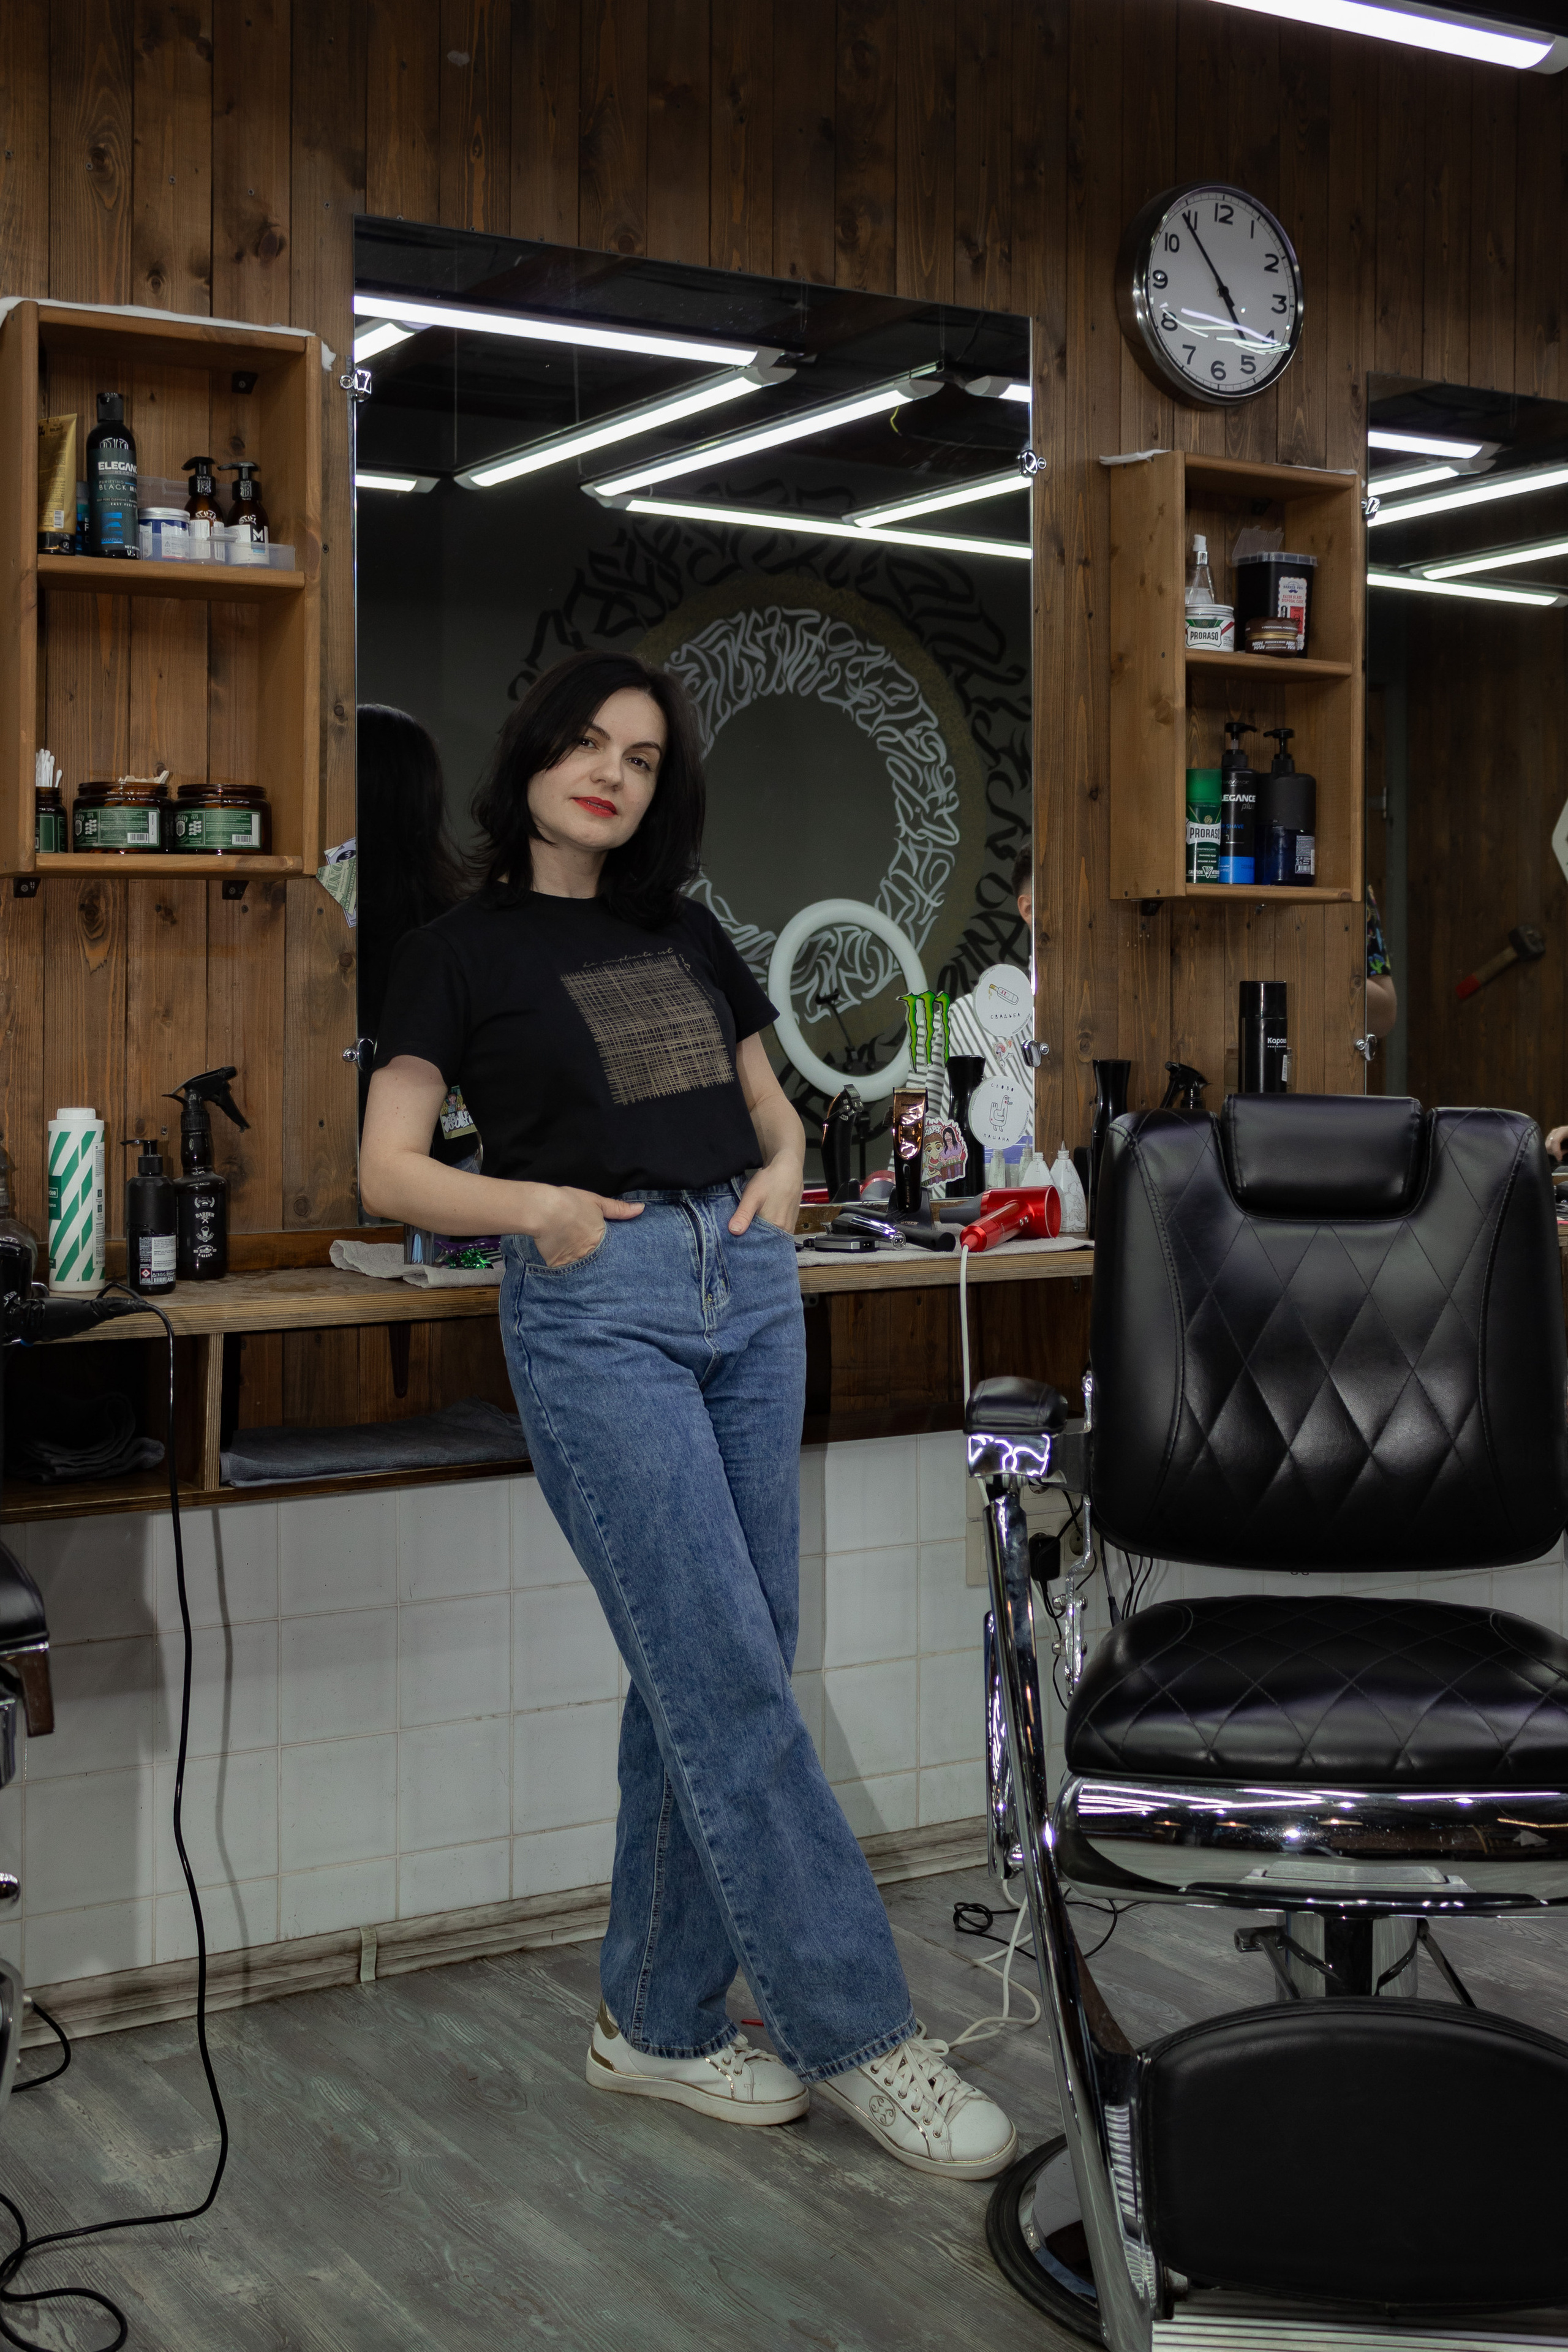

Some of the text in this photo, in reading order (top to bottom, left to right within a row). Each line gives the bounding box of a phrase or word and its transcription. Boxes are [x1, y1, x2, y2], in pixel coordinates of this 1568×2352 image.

[1214, 203, 1235, 225] 12
[1250, 220, 1255, 239] 1
[1164, 232, 1180, 253] 10
[1264, 254, 1280, 273] 2
[1152, 270, 1168, 290] 9
[1271, 294, 1287, 314] 3
[1161, 311, 1178, 332] 8
[1182, 344, 1196, 365] 7
[1210, 360, 1227, 381] 6
[1240, 355, 1256, 375] 5
[1190, 631, 1218, 641] PRORASO
[657, 947, 674, 956] est
[991, 1083, 1014, 1092] СЛОВО
[983, 1133, 1009, 1142] ПАЦАНА
